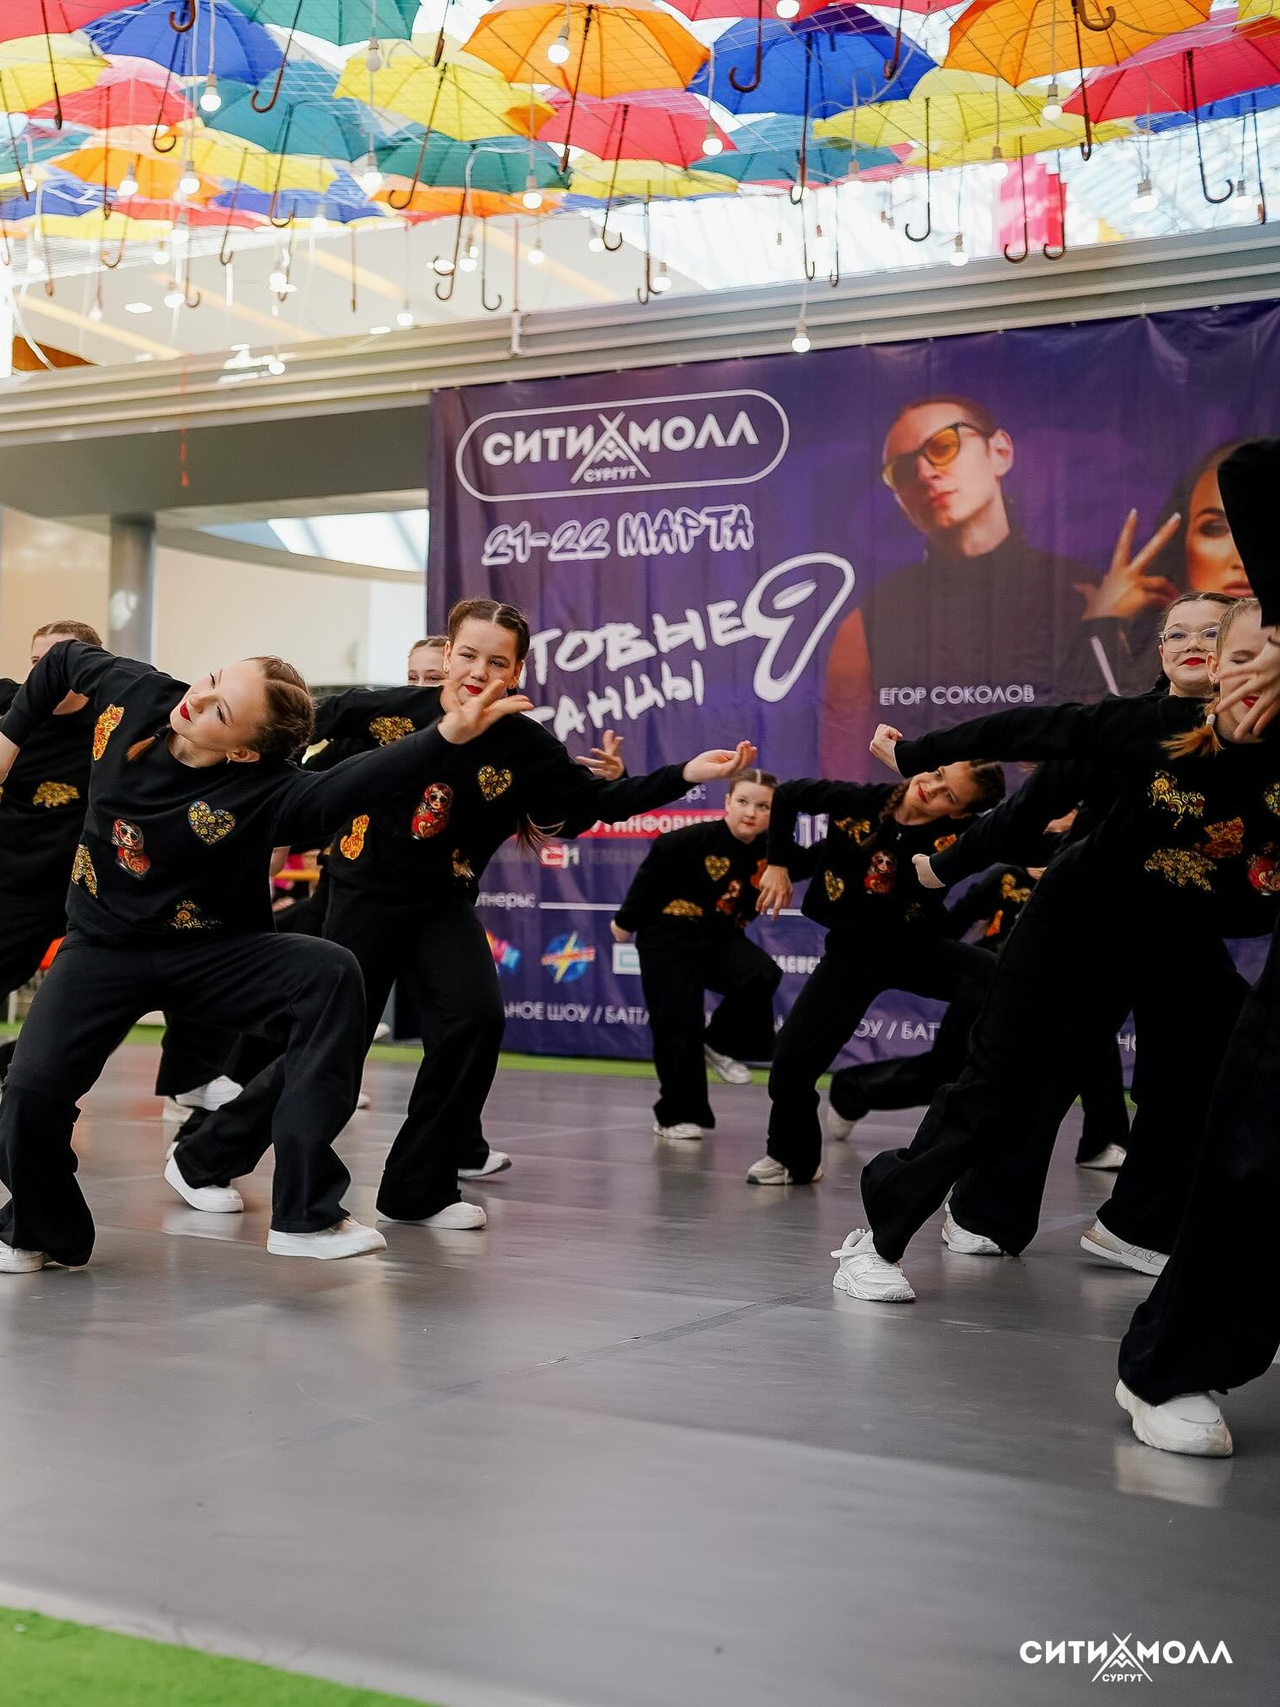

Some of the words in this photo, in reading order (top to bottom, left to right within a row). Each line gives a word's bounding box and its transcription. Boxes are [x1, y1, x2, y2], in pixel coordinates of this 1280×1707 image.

[583, 465, 637, 483] СУРГУТ
[481, 517, 611, 566] 21-22
[617, 503, 754, 557] МАРТА
[520, 600, 756, 690] ТОВЫЕ
[879, 687, 927, 705] ЕГОР
[930, 684, 1035, 705] СОКОЛОВ
[547, 1002, 591, 1022] ШОУ
